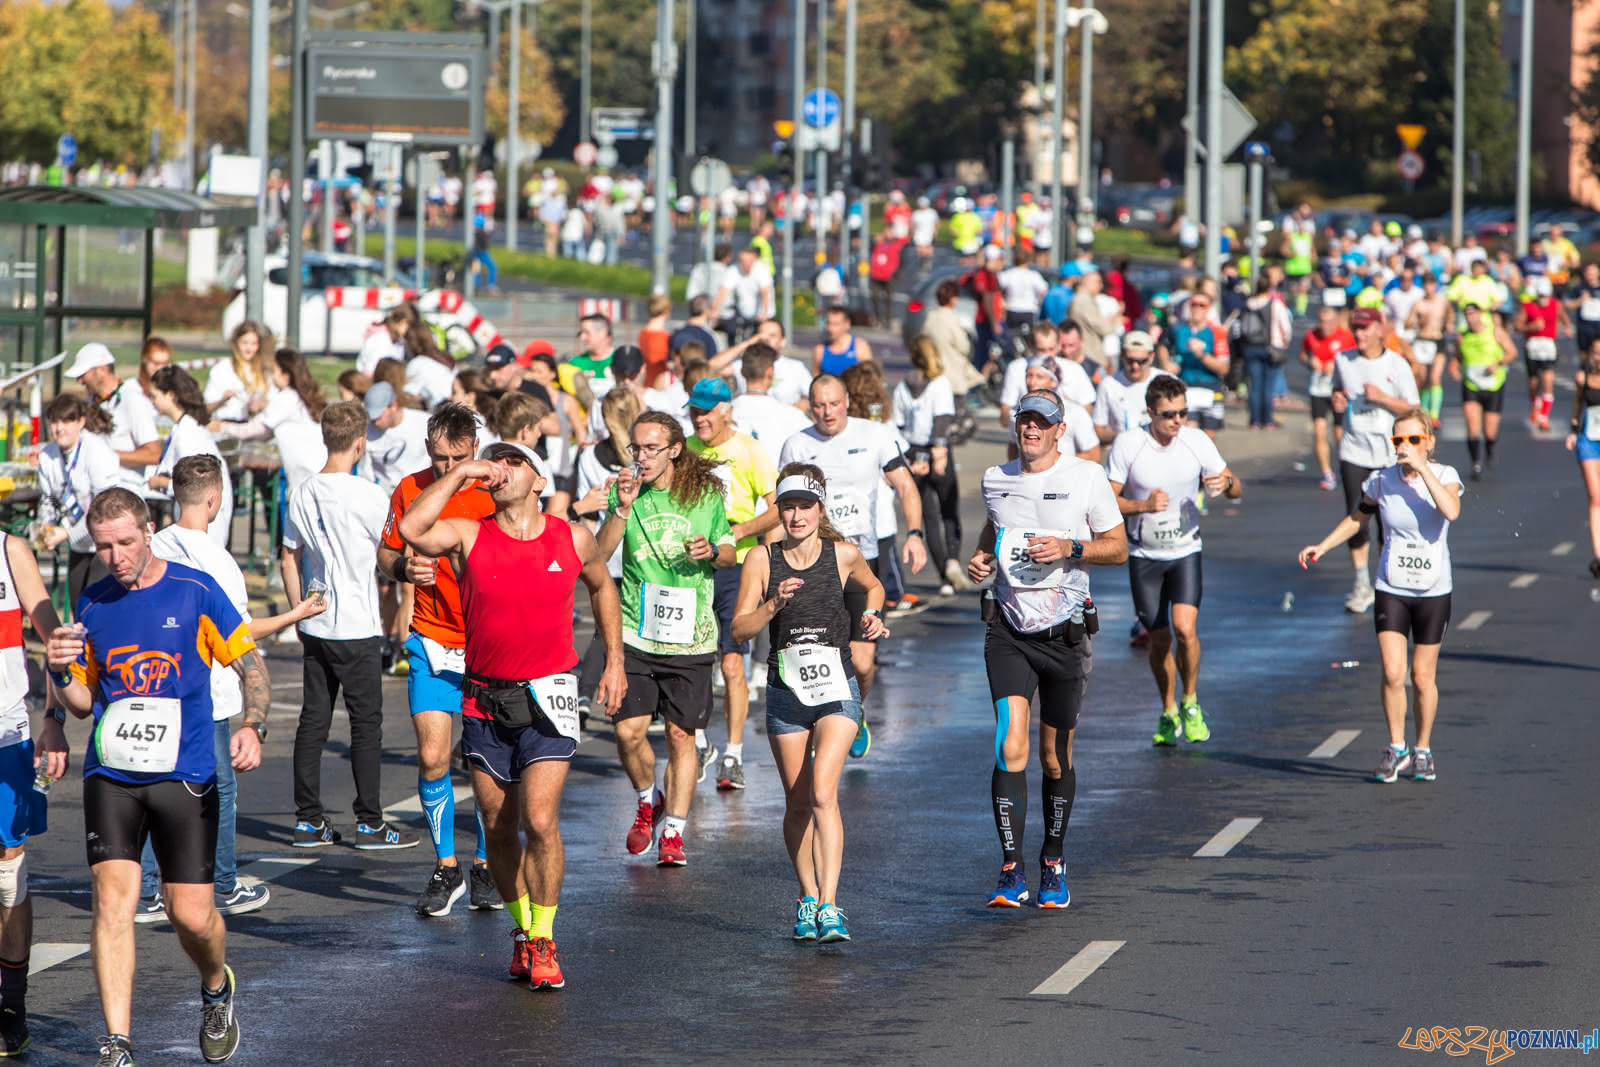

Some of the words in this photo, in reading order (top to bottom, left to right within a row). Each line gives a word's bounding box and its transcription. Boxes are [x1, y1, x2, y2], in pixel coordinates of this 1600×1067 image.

[829, 504, 859, 518] 1924
[1010, 547, 1054, 565] 55
[1398, 556, 1432, 570] 3206
[653, 604, 684, 620] 1873
[136, 659, 171, 694] SPP
[799, 663, 831, 682] 830
[115, 722, 168, 743] 4457
